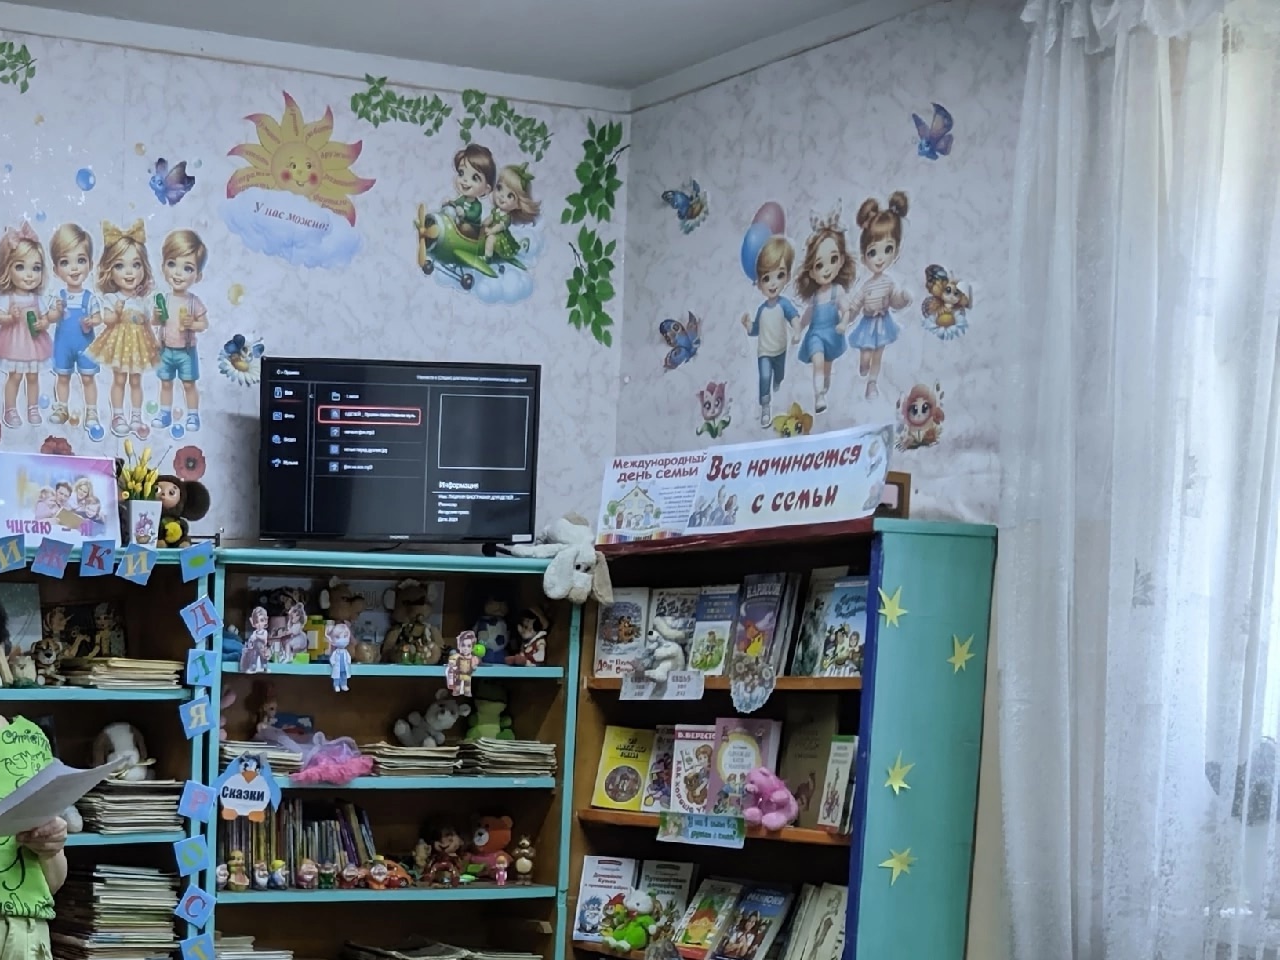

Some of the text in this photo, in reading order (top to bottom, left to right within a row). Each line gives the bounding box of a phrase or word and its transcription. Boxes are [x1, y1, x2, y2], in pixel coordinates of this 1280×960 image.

[253, 201, 265, 213] У
[265, 207, 285, 220] нас
[612, 452, 708, 471] Международный
[706, 444, 863, 481] Все начинается
[616, 466, 699, 483] день семьи
[751, 484, 839, 514] с семьи
[6, 519, 52, 535] читаю
[221, 786, 265, 802] Сказки
